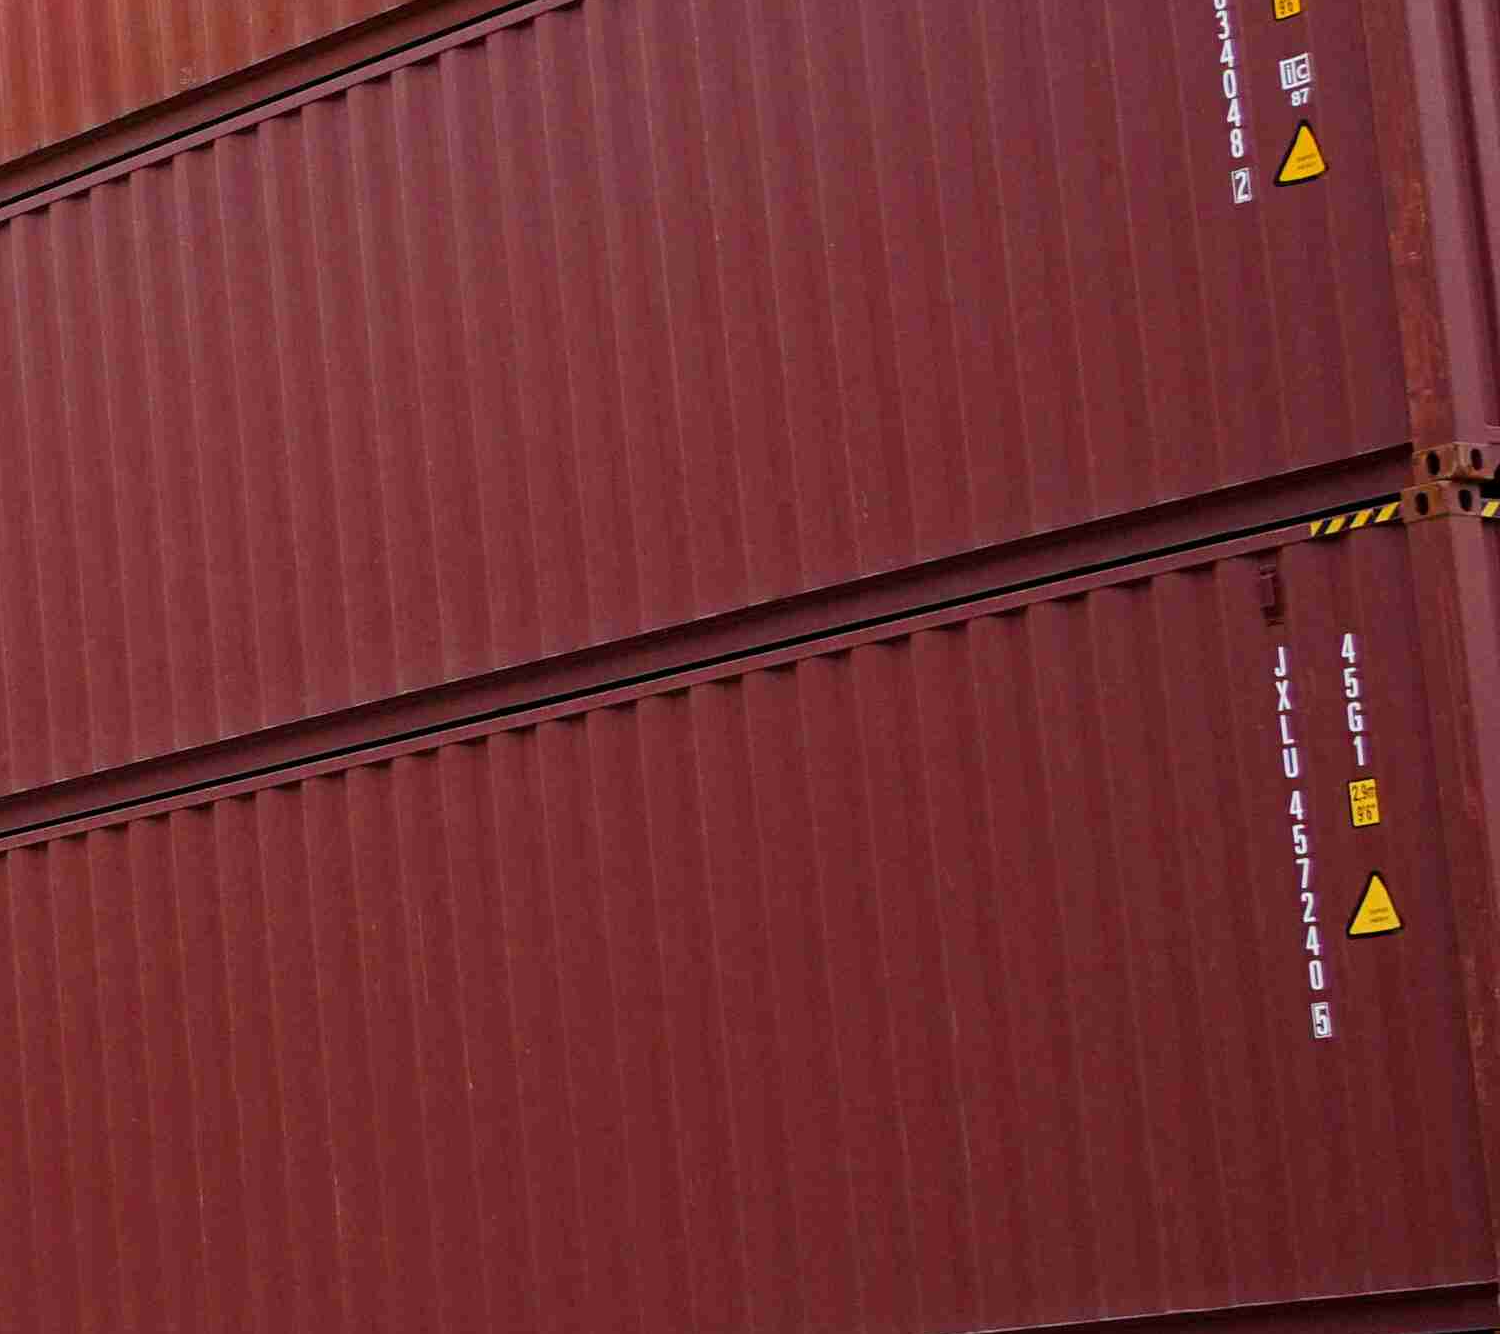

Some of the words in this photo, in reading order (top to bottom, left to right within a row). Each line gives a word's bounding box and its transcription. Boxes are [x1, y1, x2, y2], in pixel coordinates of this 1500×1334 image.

[1233, 168, 1250, 202] 2
[1341, 632, 1364, 766] 45G1
[1273, 646, 1300, 778] JXLU
[1288, 789, 1324, 991] 457240
[1313, 1004, 1330, 1037] 5
